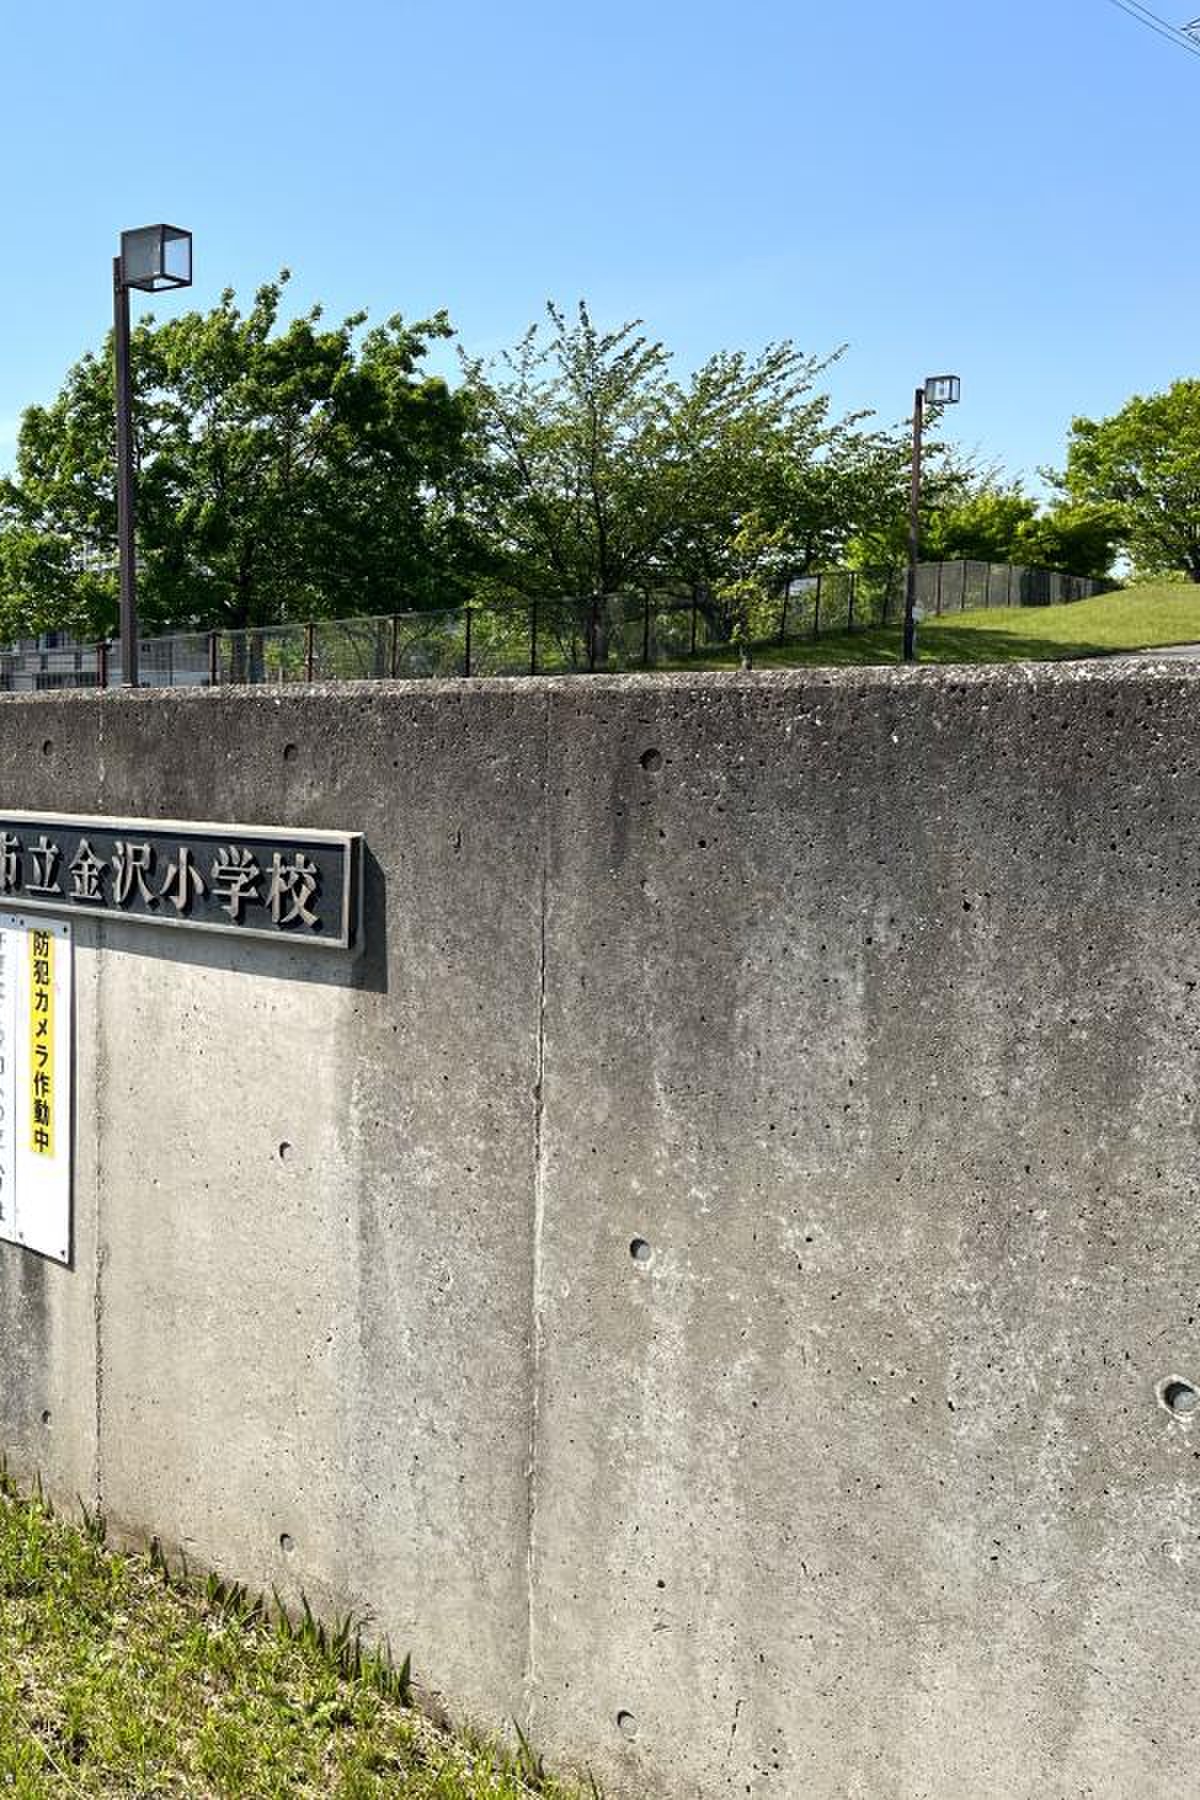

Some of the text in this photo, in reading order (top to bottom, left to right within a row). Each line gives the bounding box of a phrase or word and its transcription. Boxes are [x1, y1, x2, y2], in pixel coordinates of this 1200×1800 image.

[33, 930, 50, 1153] 防犯カメラ作動中
